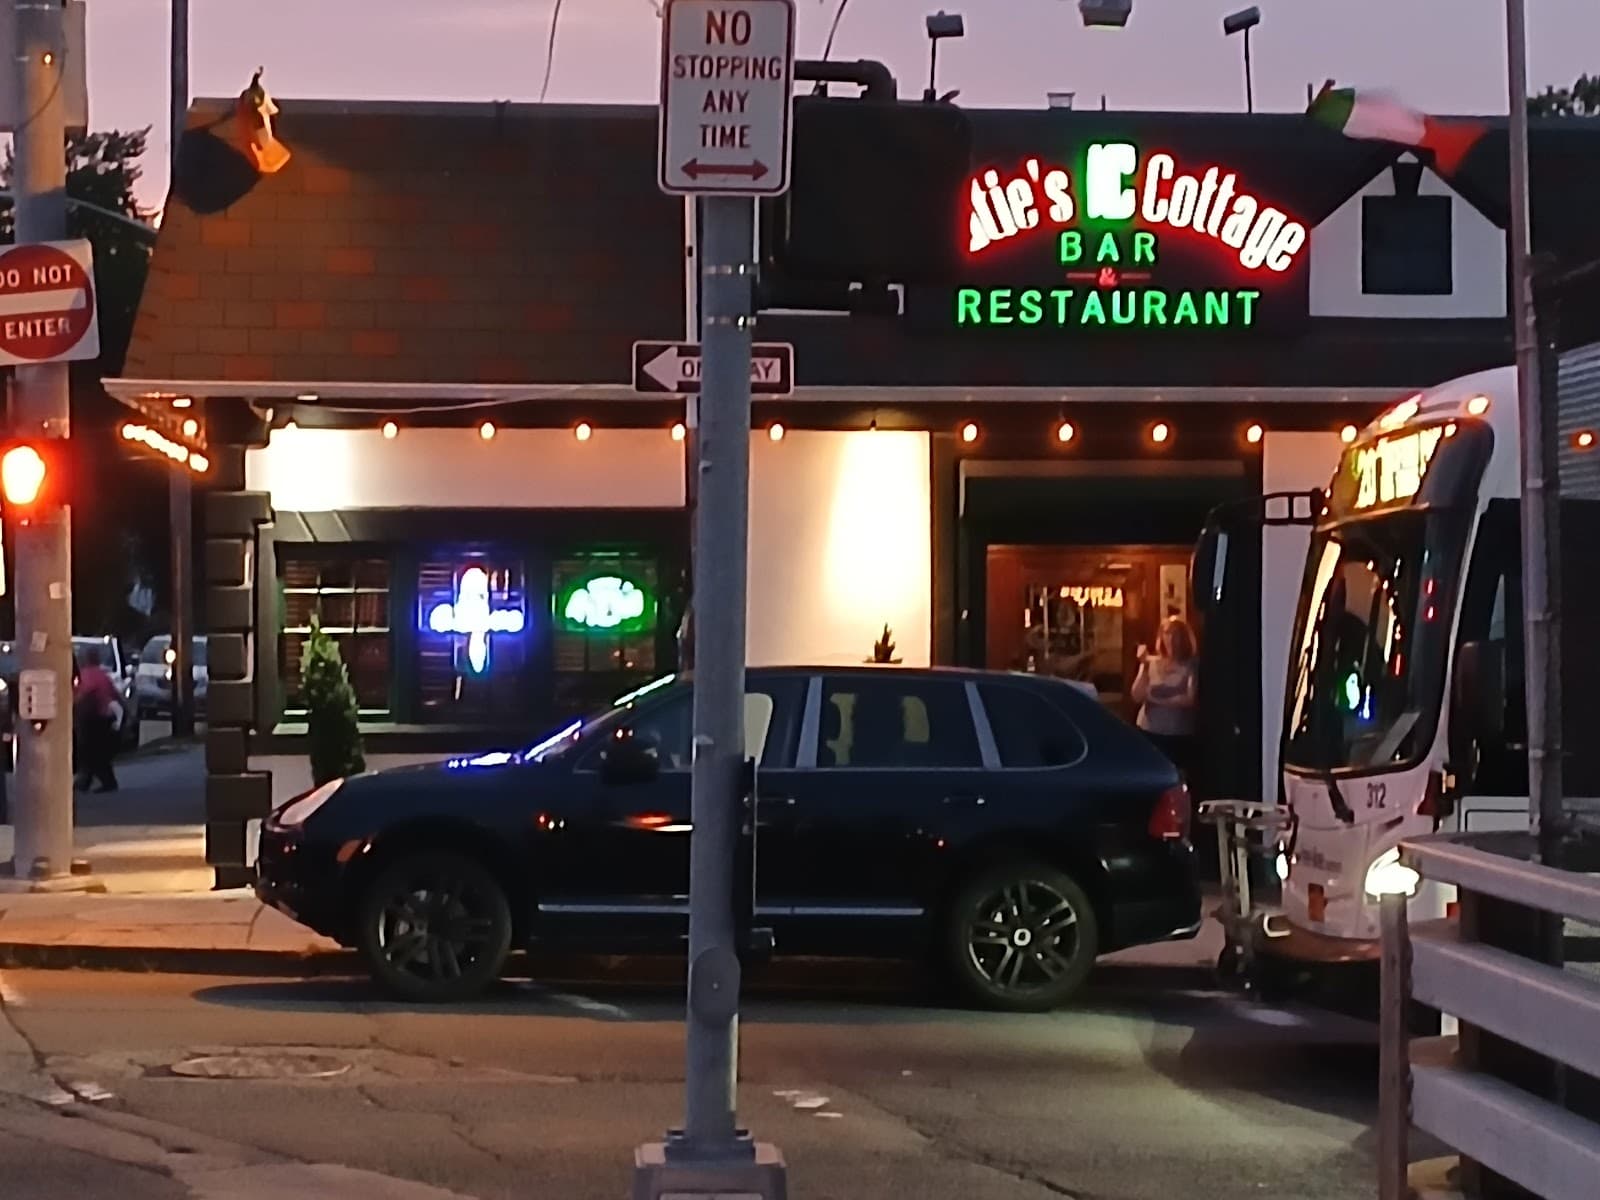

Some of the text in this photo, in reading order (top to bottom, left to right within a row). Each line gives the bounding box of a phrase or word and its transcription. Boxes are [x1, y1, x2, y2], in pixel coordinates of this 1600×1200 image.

[705, 9, 752, 46] NO
[673, 54, 782, 80] STOPPING
[702, 89, 750, 113] ANY
[700, 124, 751, 149] TIME
[1142, 153, 1306, 272] Cottage
[1060, 231, 1156, 262] BAR
[33, 264, 72, 285] NOT
[1099, 266, 1118, 287] &
[957, 288, 1261, 325] RESTAURANT
[5, 317, 71, 340] ENTER
[750, 360, 775, 381] AY
[1366, 783, 1386, 808] 312
